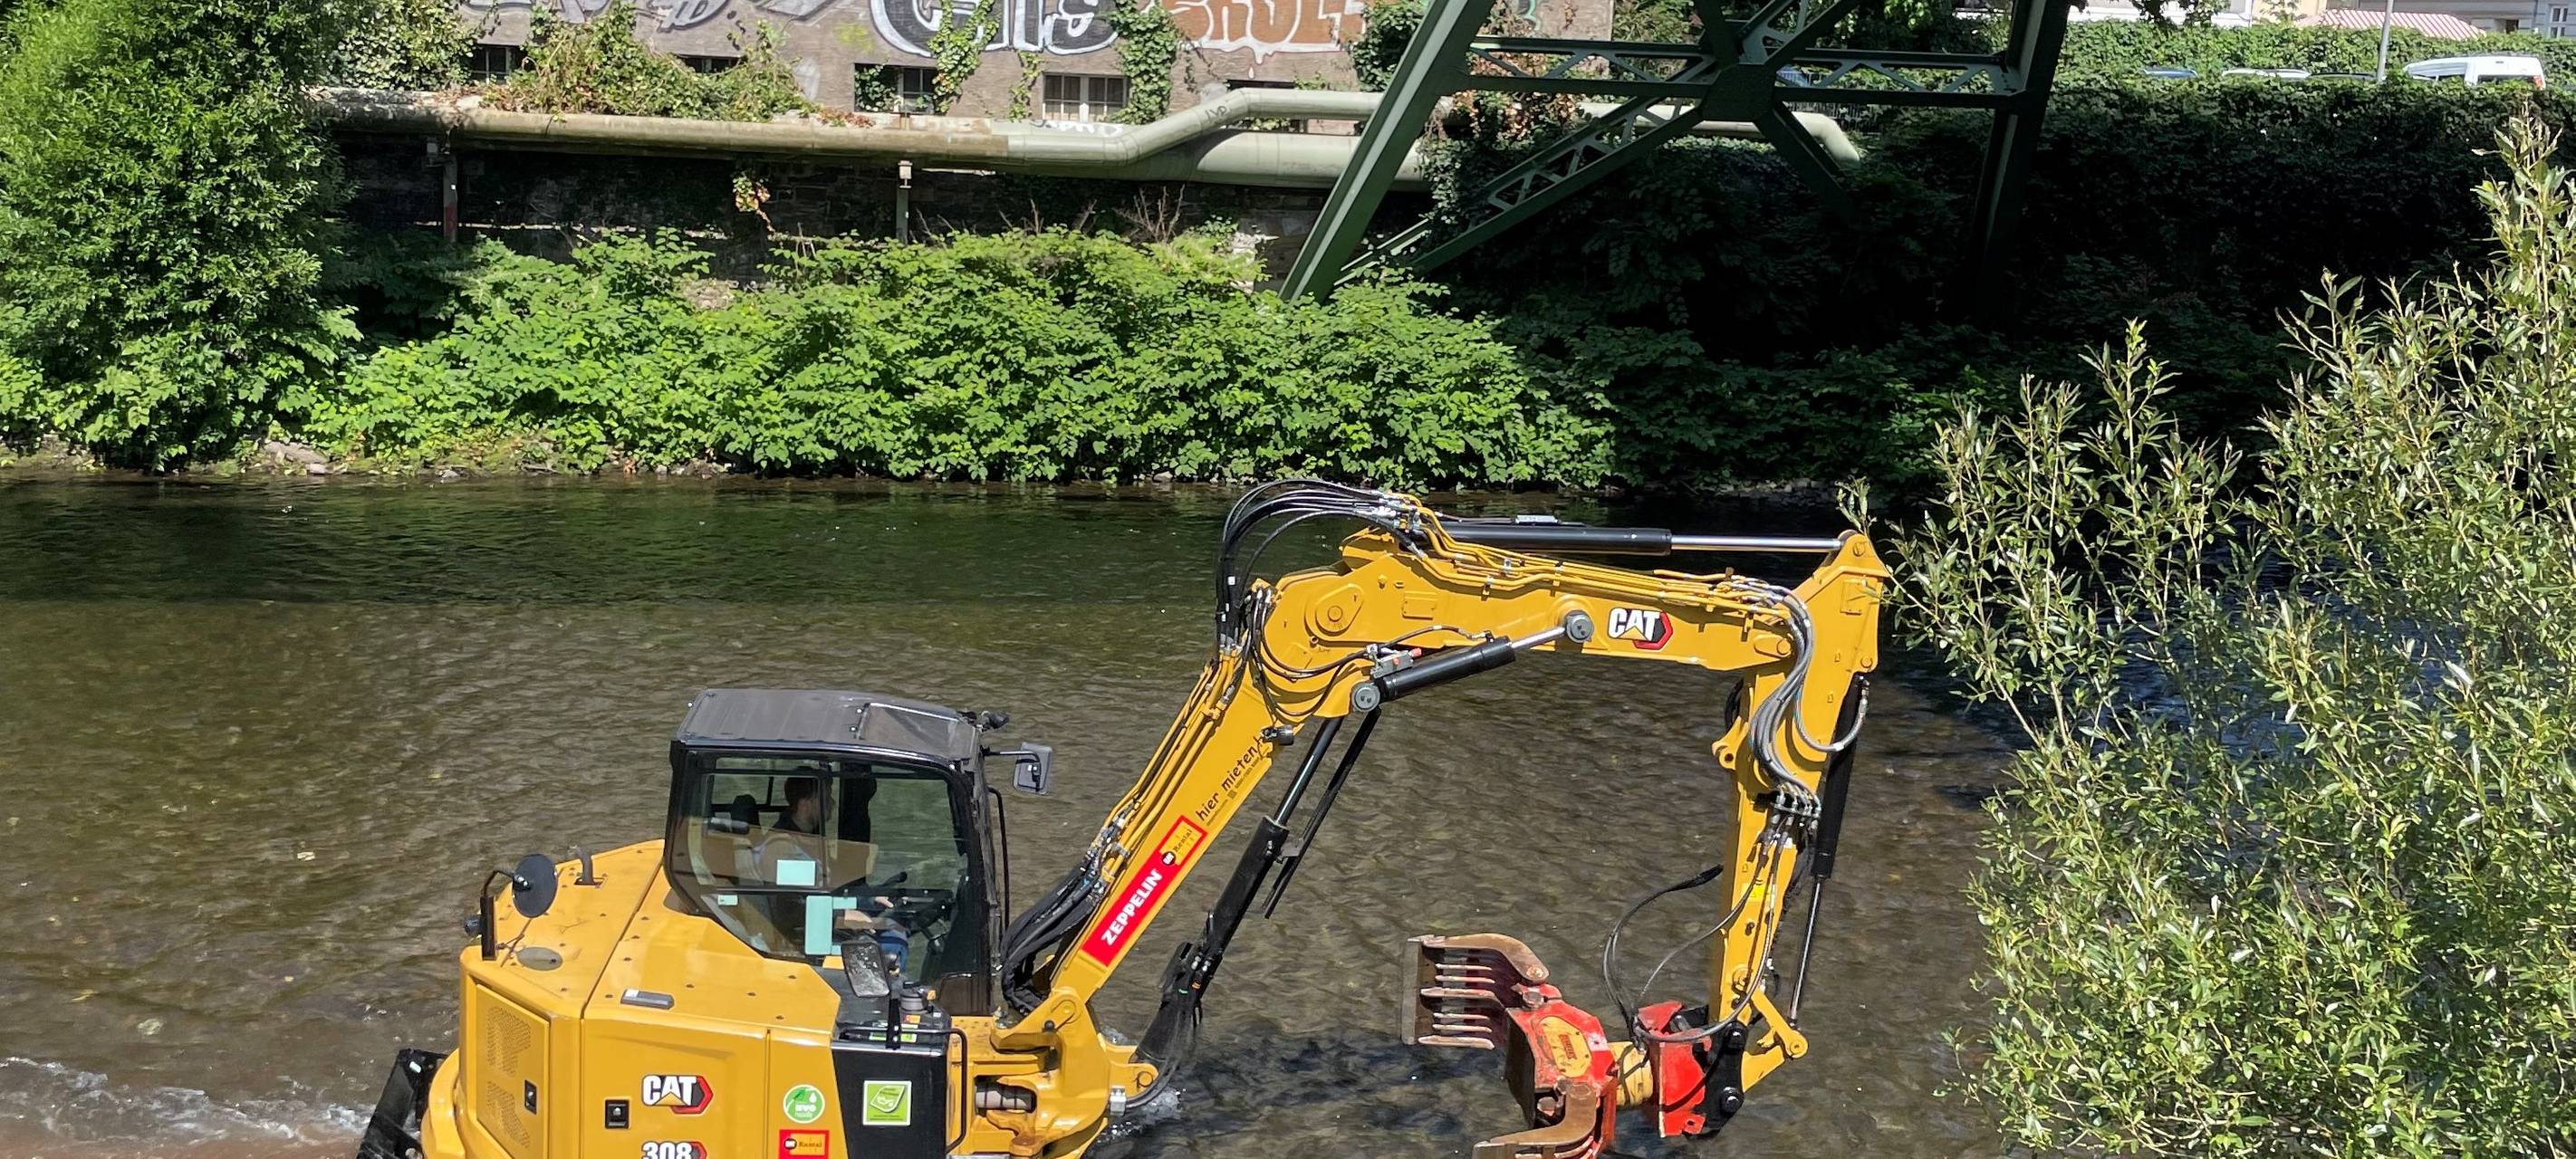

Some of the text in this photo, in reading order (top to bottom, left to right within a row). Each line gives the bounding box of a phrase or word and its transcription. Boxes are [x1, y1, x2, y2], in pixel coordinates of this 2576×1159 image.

[1609, 608, 1660, 641] CAT
[1196, 792, 1219, 821] hier
[1101, 868, 1163, 946] ZEPPELIN
[642, 1075, 697, 1106] CAT
[642, 1142, 692, 1159] 308
